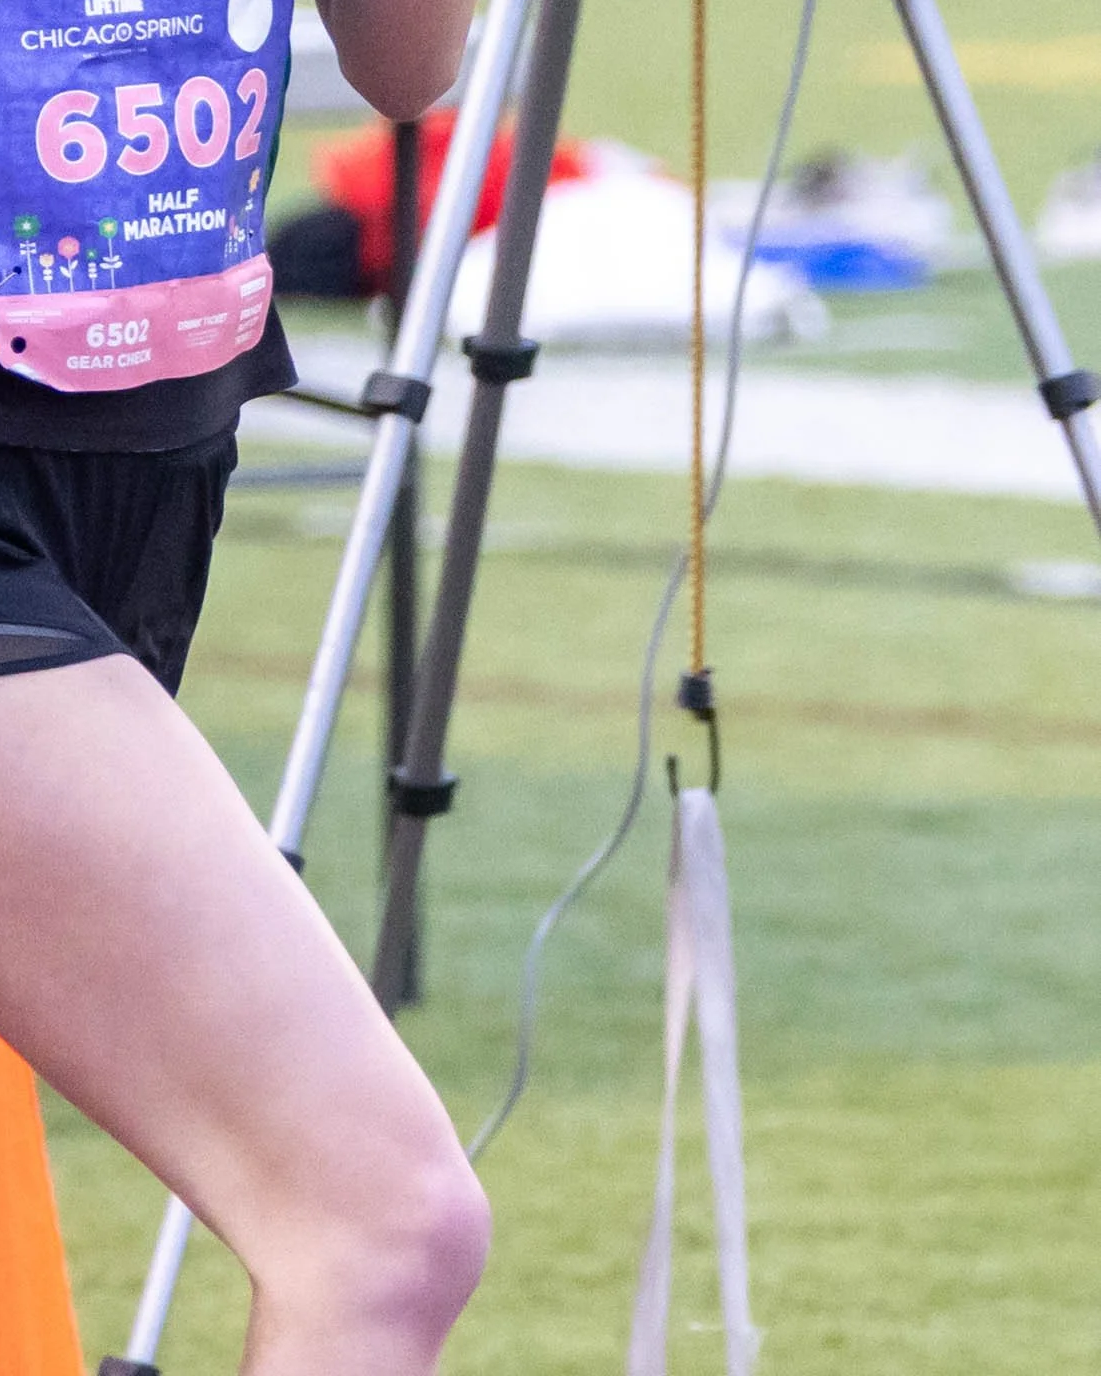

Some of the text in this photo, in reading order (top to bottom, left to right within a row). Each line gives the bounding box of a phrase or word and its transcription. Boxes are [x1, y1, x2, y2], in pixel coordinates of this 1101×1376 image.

[20, 14, 203, 51] CHICAGO SPRING
[35, 68, 268, 183] 6502
[148, 187, 199, 212] HALF
[124, 209, 226, 241] MARATHON
[86, 318, 150, 347] 6502
[66, 349, 151, 369] GEAR CHECK
